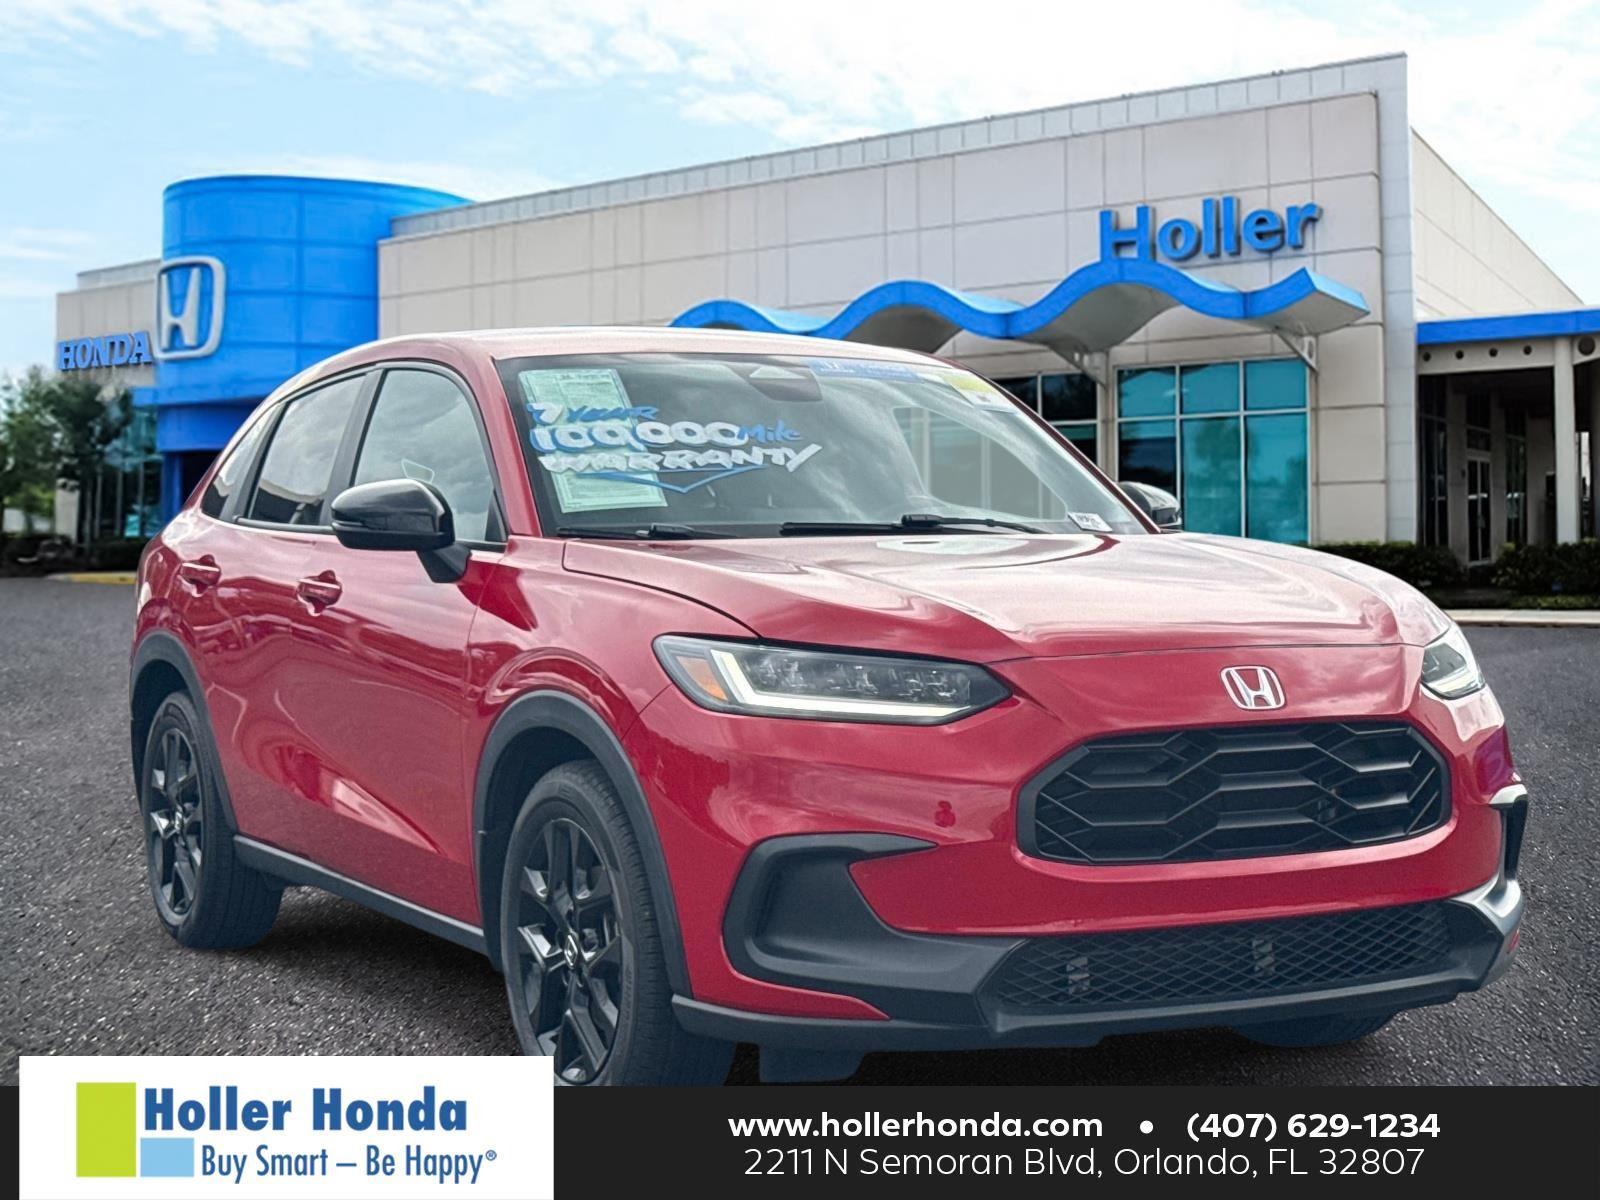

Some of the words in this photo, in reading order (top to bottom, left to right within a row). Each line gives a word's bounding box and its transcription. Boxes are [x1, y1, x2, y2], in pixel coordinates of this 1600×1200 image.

[1099, 195, 1323, 261] Holler
[57, 331, 152, 370] HONDA
[538, 443, 823, 473] WARRANTY
